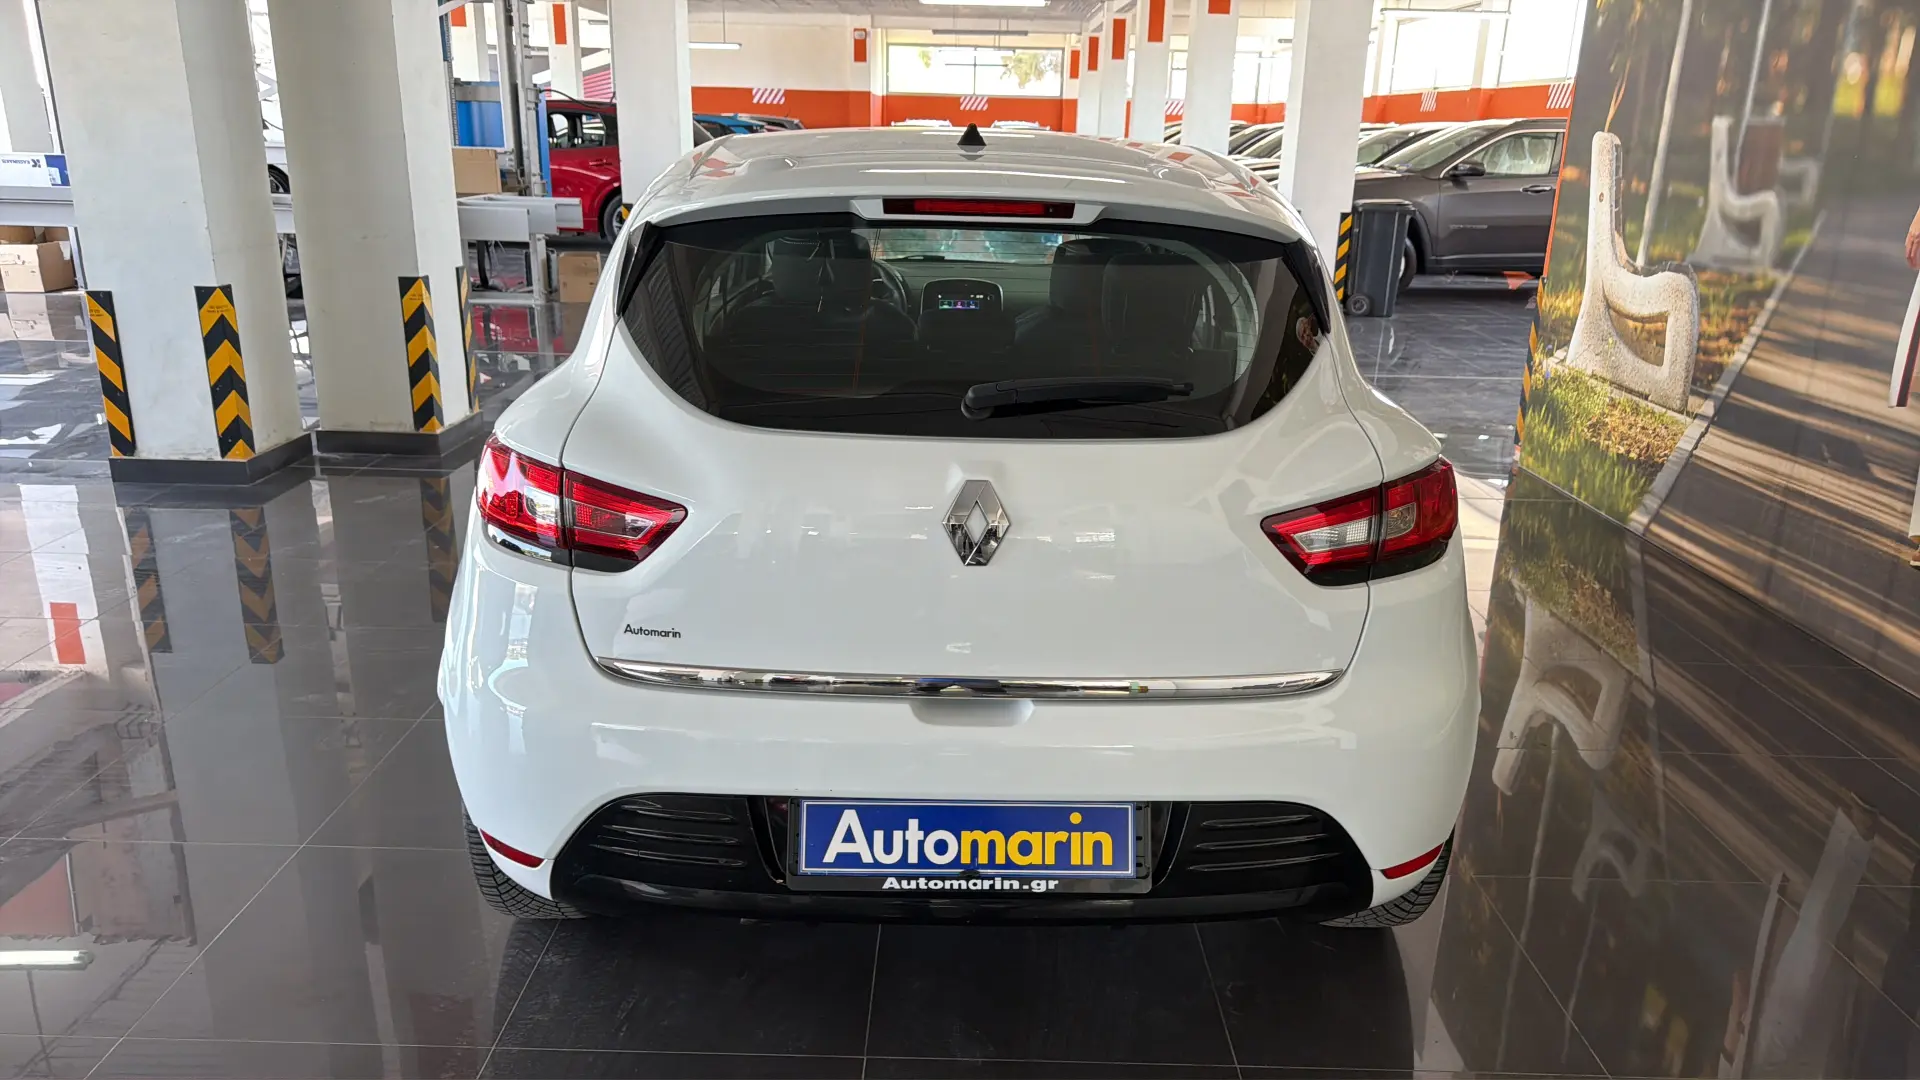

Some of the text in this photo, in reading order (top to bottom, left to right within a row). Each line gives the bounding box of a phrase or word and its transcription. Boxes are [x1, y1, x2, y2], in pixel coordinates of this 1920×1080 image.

[623, 623, 681, 639] Automarin
[822, 809, 1112, 866] Automarin
[882, 877, 1059, 892] Automarin.gr
